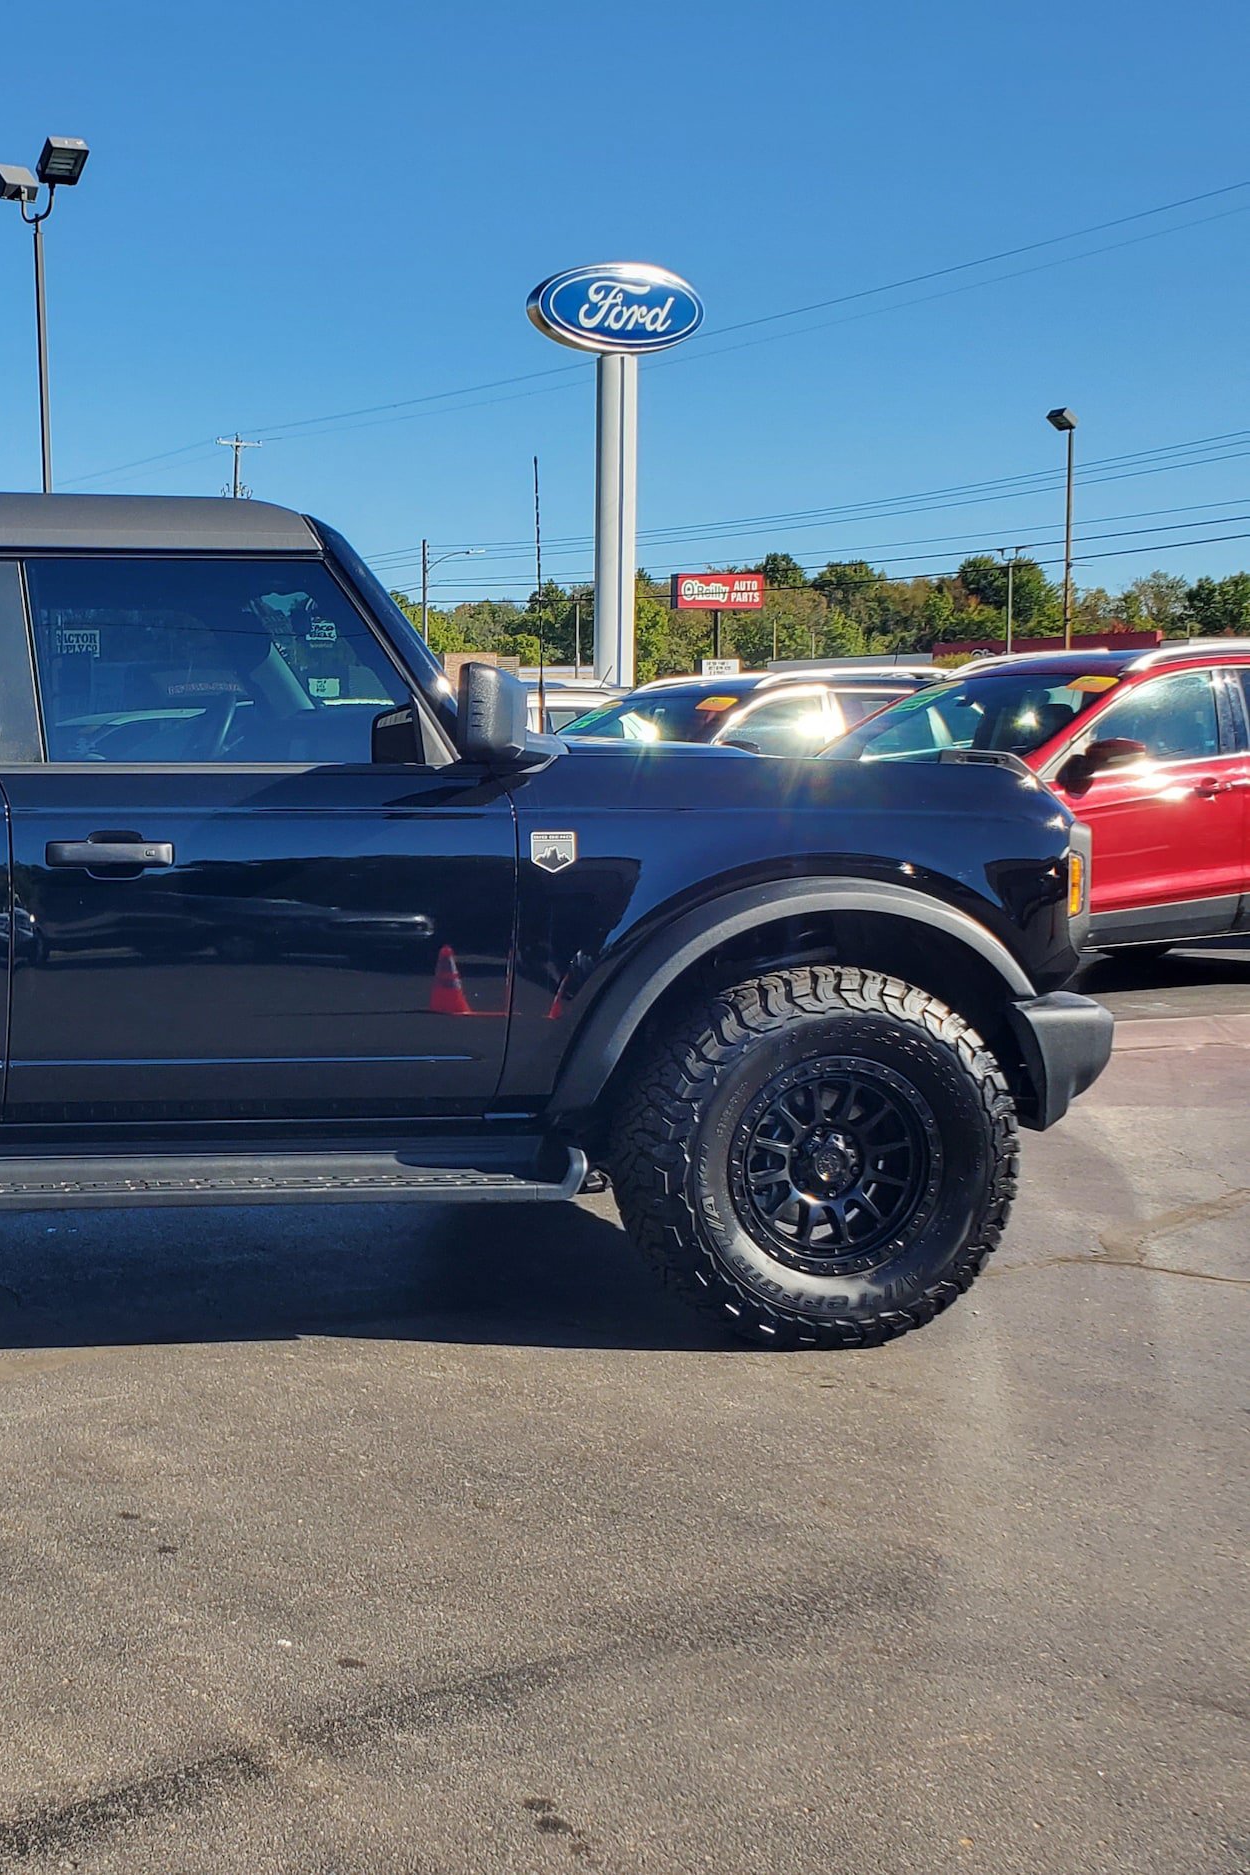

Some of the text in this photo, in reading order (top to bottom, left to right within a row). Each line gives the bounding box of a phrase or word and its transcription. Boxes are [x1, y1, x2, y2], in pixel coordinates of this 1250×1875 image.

[578, 280, 675, 333] Ford
[681, 580, 729, 602] O'Reilly
[734, 581, 758, 591] AUTO
[731, 592, 760, 603] PARTS
